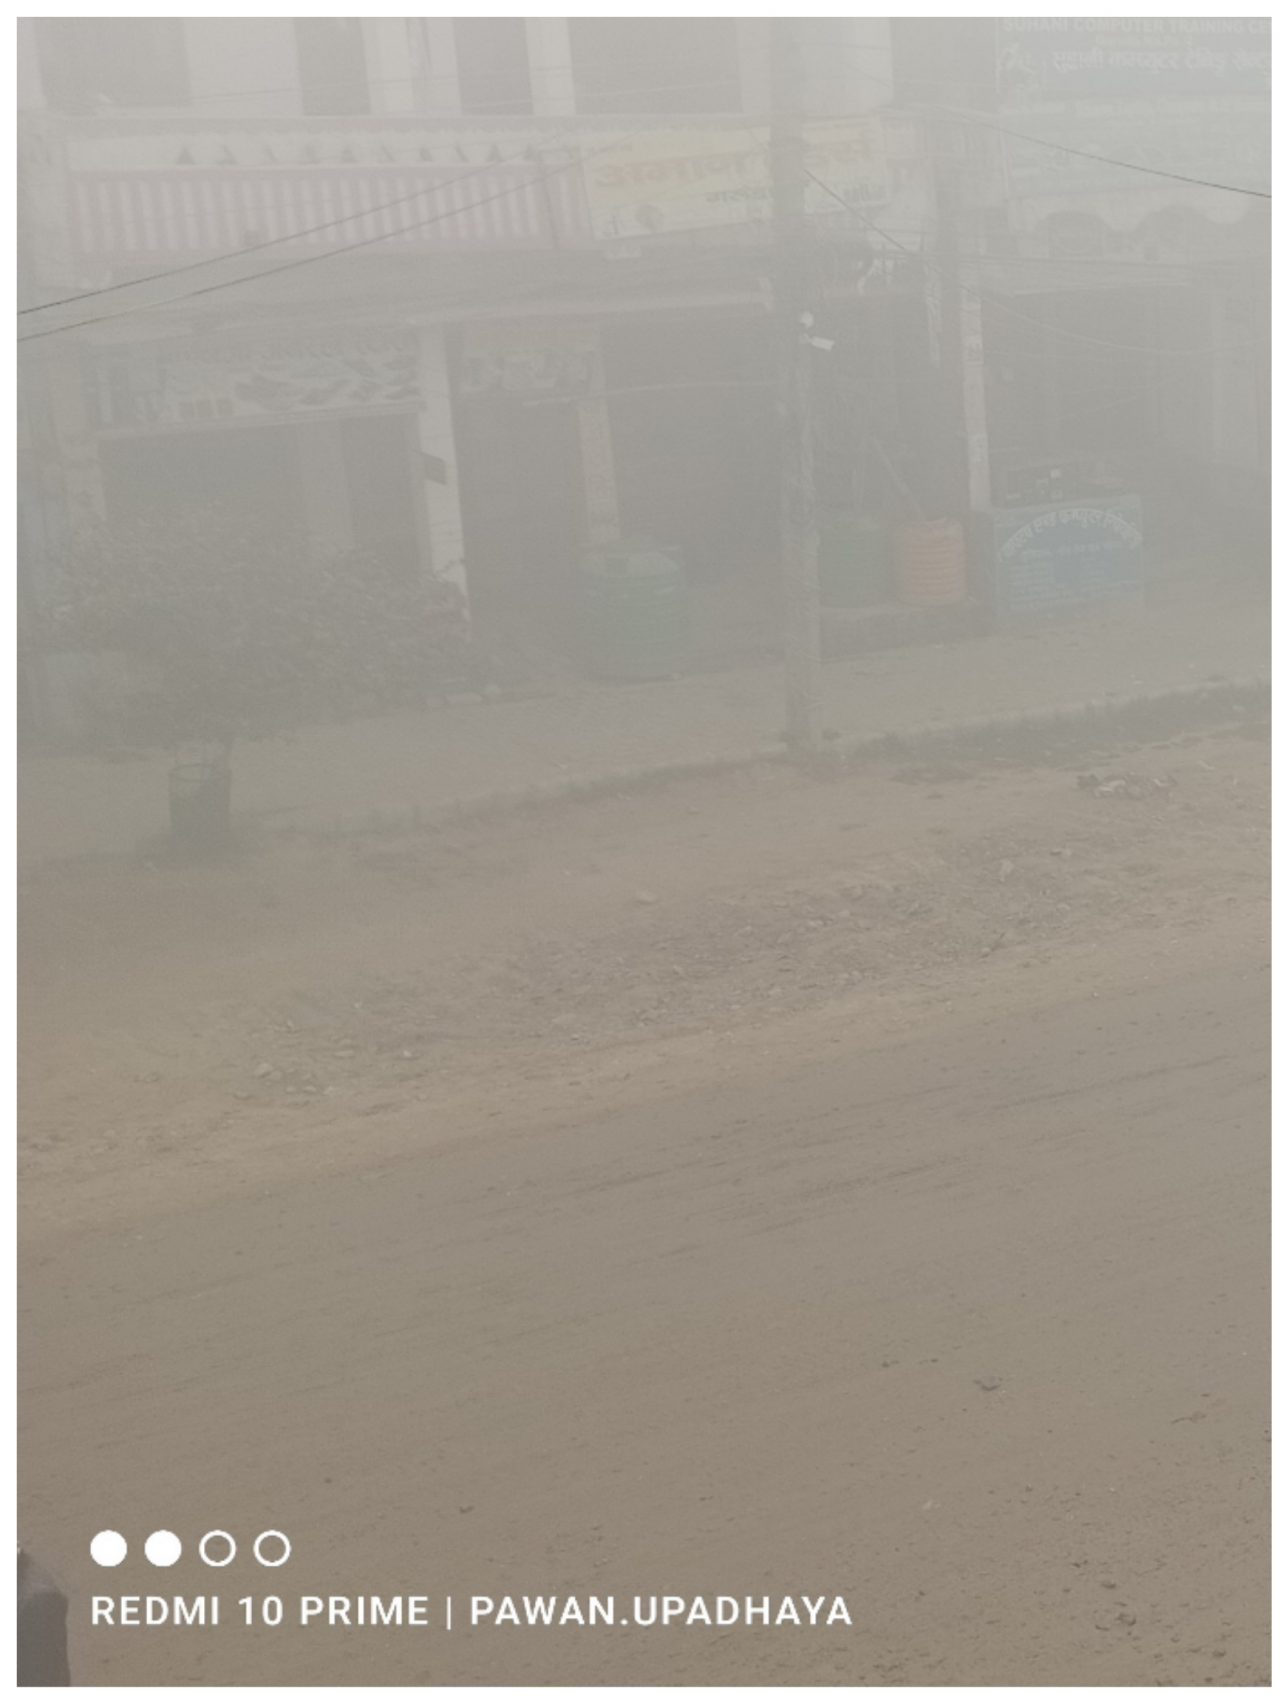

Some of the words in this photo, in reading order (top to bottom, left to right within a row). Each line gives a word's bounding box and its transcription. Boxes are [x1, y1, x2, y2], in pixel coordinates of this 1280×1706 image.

[1003, 18, 1068, 32] SUHANI
[1073, 18, 1164, 33] COMPUTER
[1170, 18, 1243, 33] TRAINING
